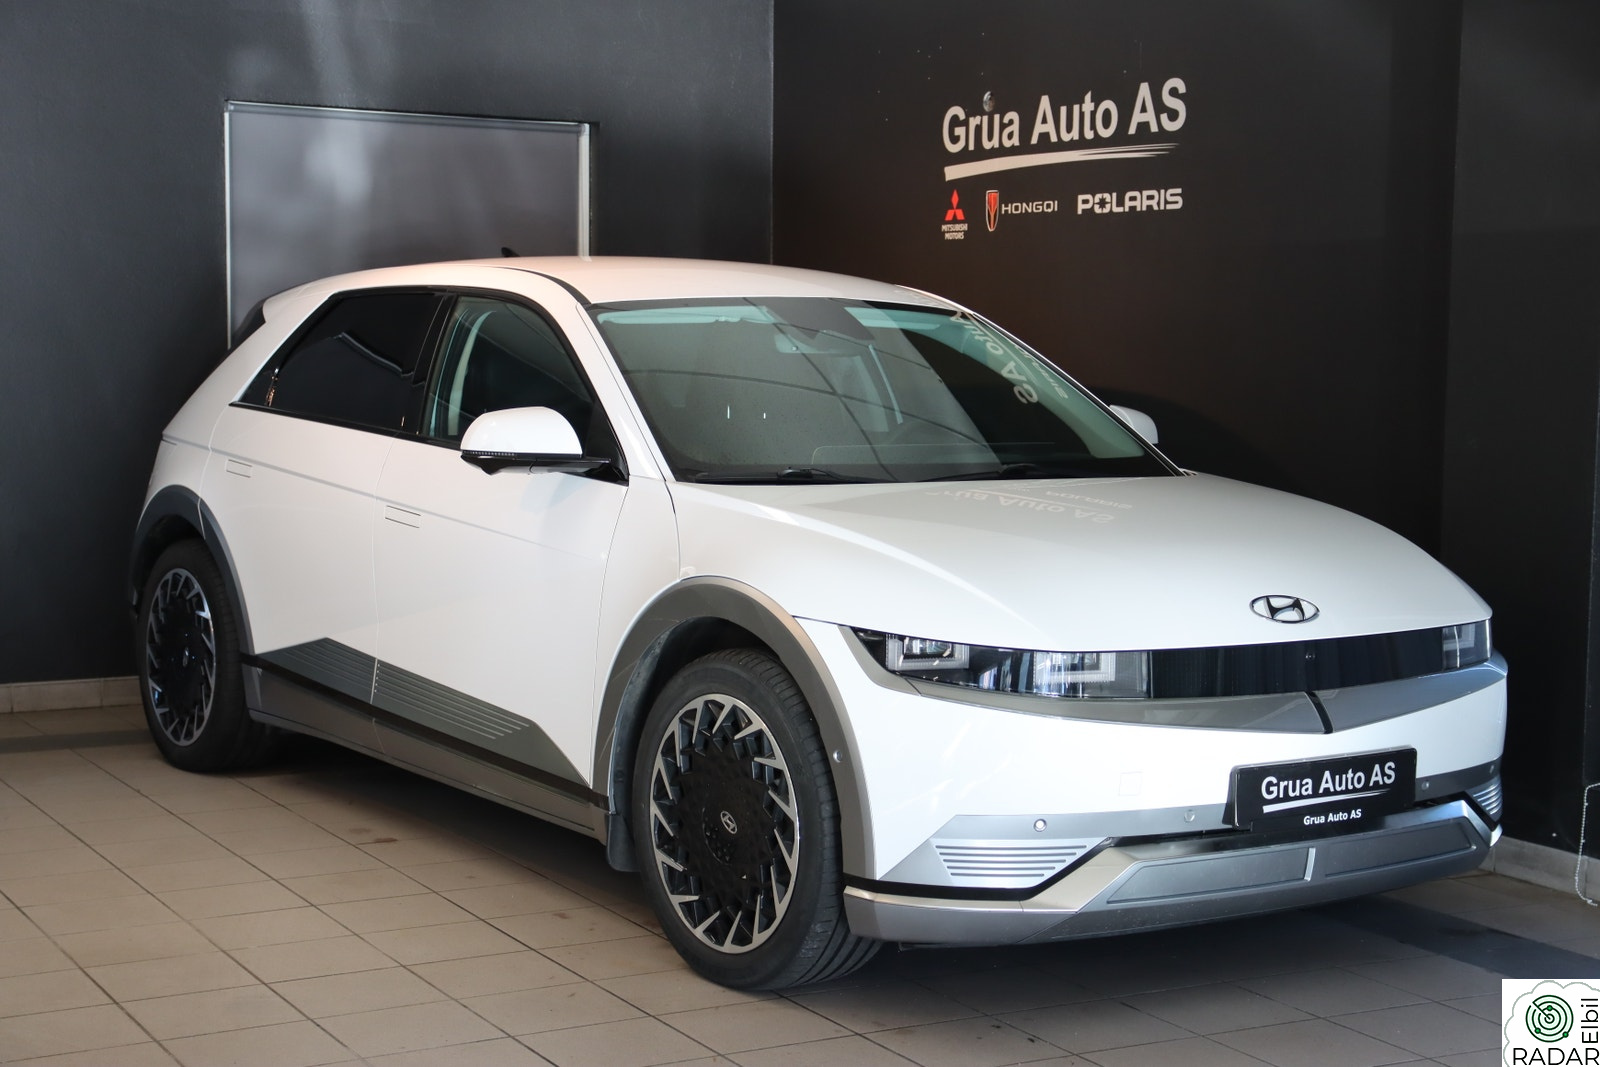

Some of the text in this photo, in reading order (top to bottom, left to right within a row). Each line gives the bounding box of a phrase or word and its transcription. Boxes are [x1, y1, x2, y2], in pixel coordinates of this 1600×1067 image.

[942, 77, 1187, 153] Grua Auto AS
[1001, 188, 1183, 215] HONGQI POLARIS
[1261, 761, 1396, 800] Grua Auto AS
[1303, 809, 1362, 826] Grua Auto AS
